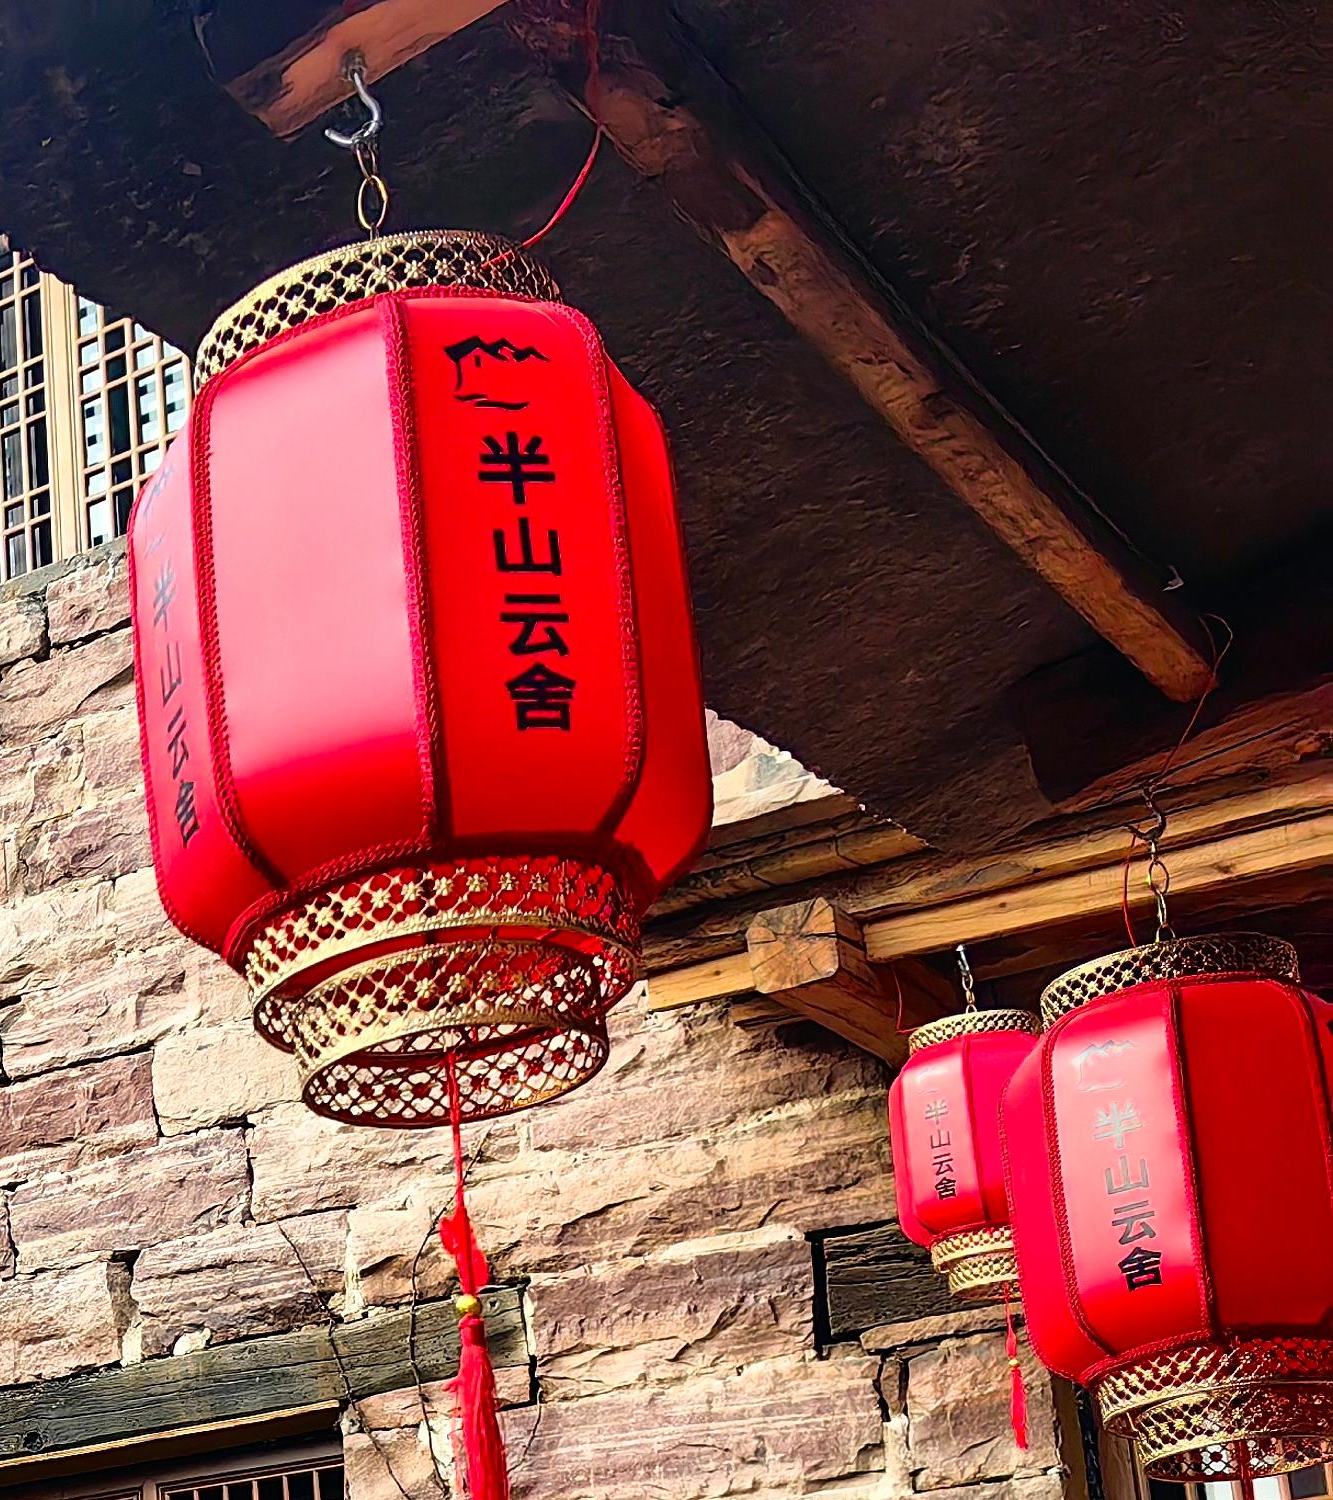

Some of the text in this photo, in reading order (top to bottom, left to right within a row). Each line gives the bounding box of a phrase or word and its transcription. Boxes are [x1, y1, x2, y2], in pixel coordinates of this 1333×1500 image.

[478, 431, 577, 731] 半山云舍
[153, 557, 200, 849] 半山云舍
[924, 1099, 957, 1200] 半山云舍
[1093, 1101, 1163, 1291] 半山云舍
